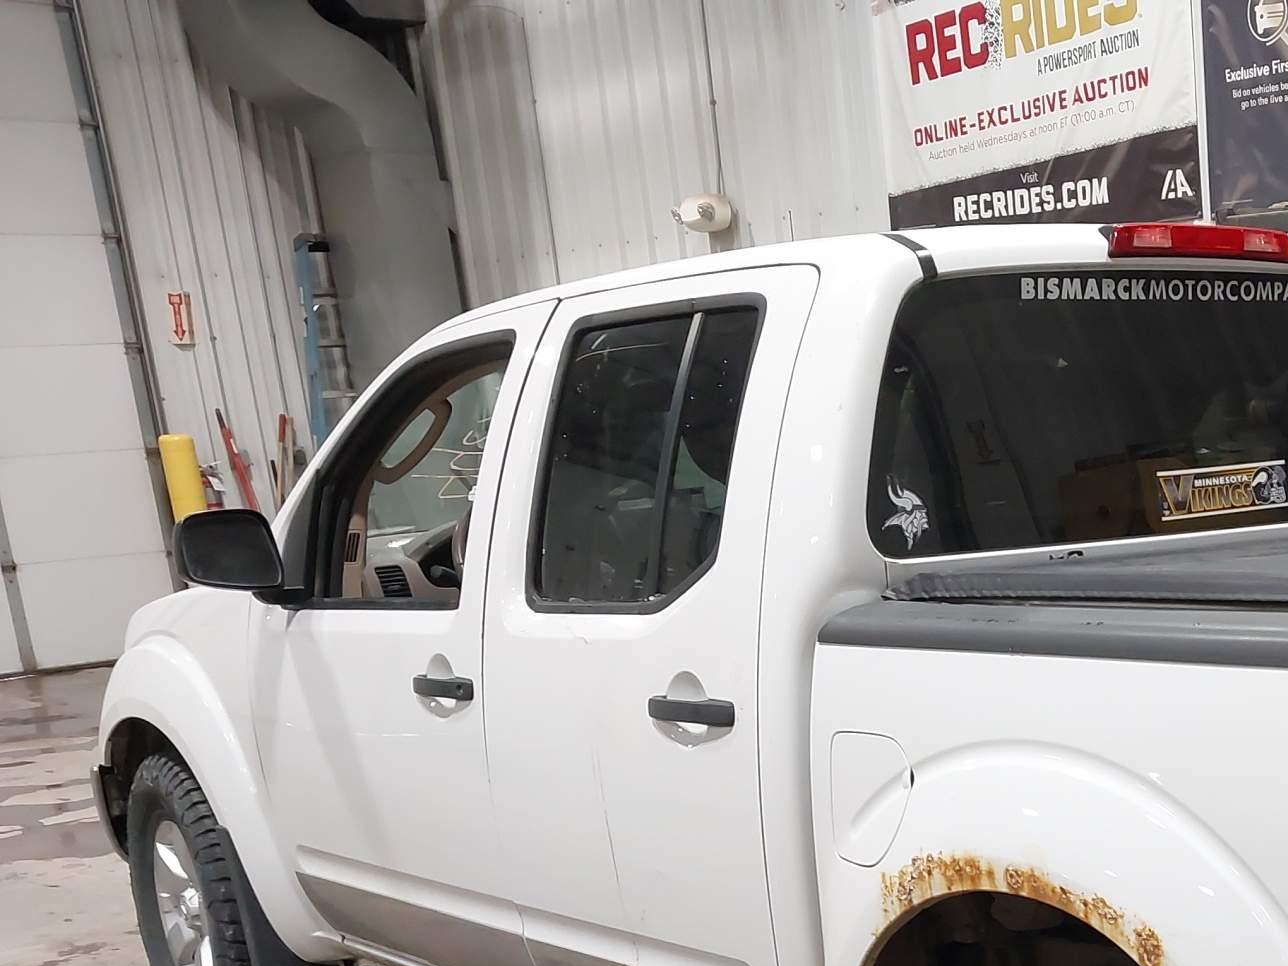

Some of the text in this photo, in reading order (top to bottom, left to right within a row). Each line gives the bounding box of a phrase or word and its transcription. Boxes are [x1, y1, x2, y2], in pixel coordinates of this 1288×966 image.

[906, 2, 989, 85] REC
[1037, 29, 1140, 76] A POWERSPORT AUCTION
[1225, 62, 1270, 82] Exclusive
[1232, 87, 1242, 98] Bid
[1243, 88, 1251, 97] on
[1251, 83, 1279, 95] vehicles
[914, 67, 1149, 146] ONLINE-EXCLUSIVE AUCTION
[1241, 101, 1250, 111] go
[1250, 98, 1257, 107] to
[1257, 96, 1268, 106] the
[1269, 94, 1283, 104] live
[928, 146, 957, 161] Auction
[958, 140, 975, 154] held
[976, 129, 1028, 151] Wednesdays
[1029, 128, 1037, 139] at
[1038, 122, 1058, 135] noon
[1118, 99, 1136, 114] CT)
[1019, 172, 1039, 184] Visit
[953, 177, 1110, 222] RECRIDES.COM
[1160, 474, 1253, 515] VIKINGS
[1194, 474, 1248, 488] MINNESOTA
